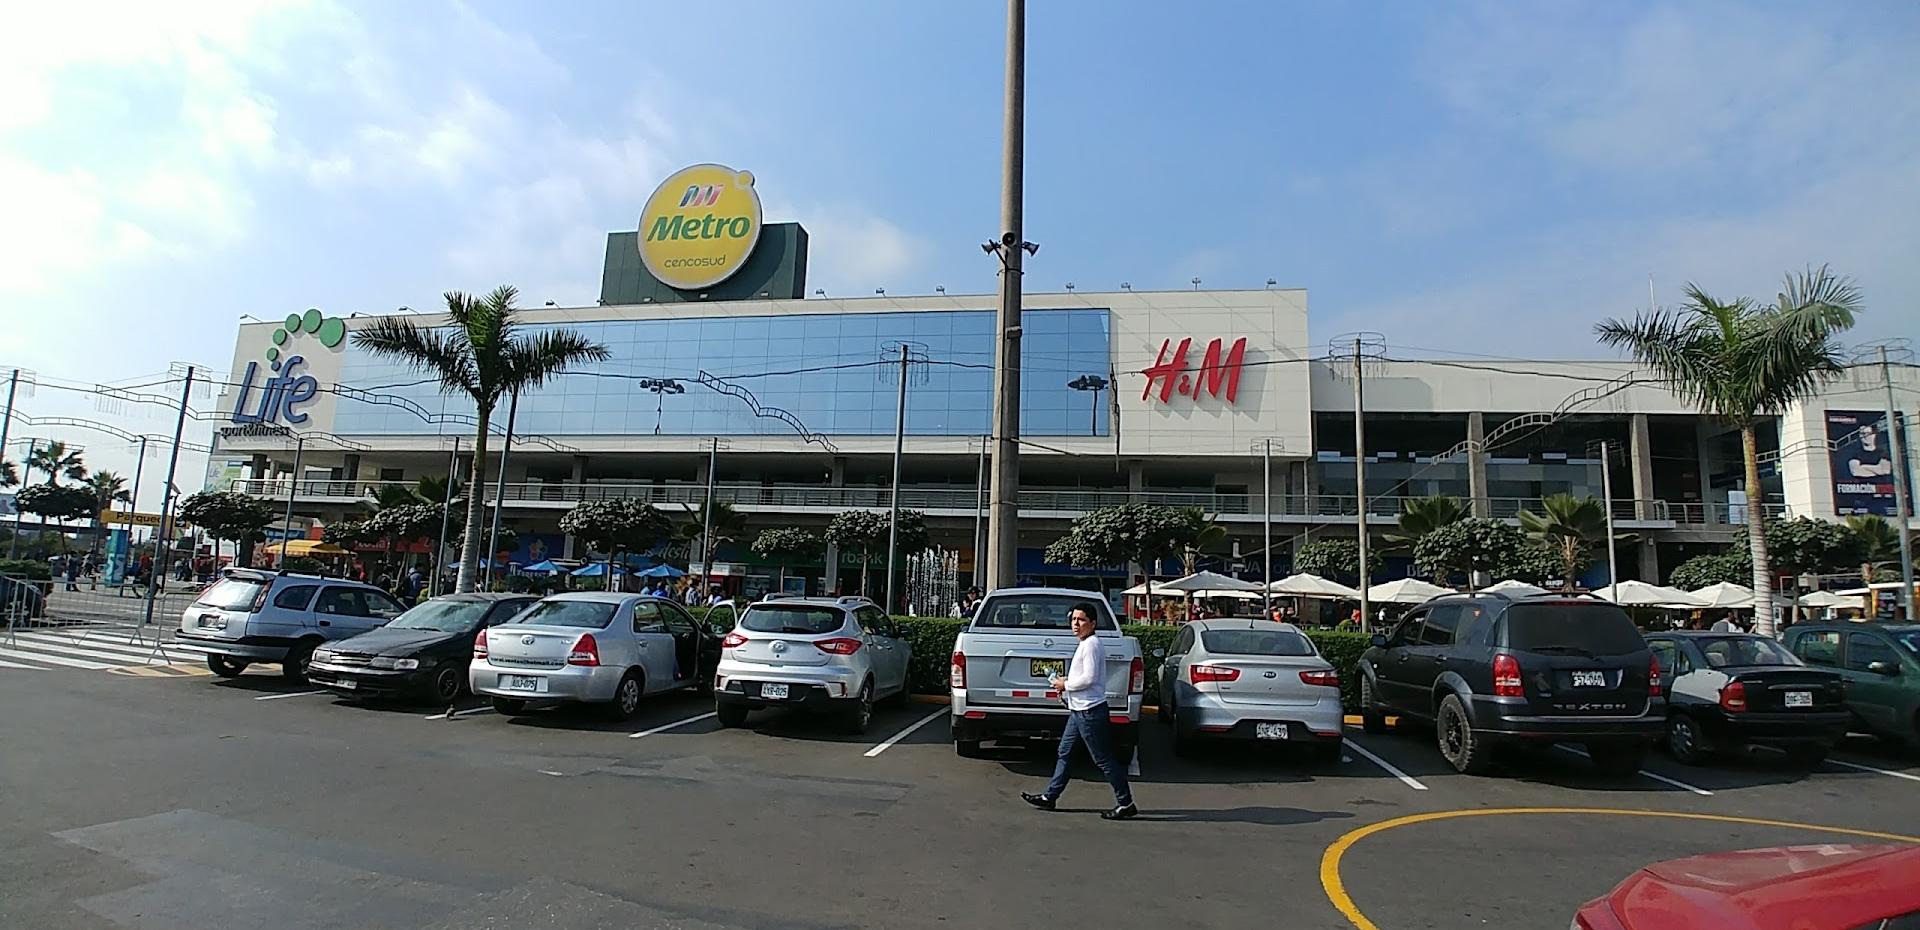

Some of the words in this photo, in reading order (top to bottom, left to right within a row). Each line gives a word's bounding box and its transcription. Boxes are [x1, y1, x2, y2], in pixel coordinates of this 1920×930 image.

[647, 213, 750, 242] Metro
[664, 255, 726, 268] cencosud
[231, 356, 317, 424] Life
[1142, 337, 1247, 403] H&M
